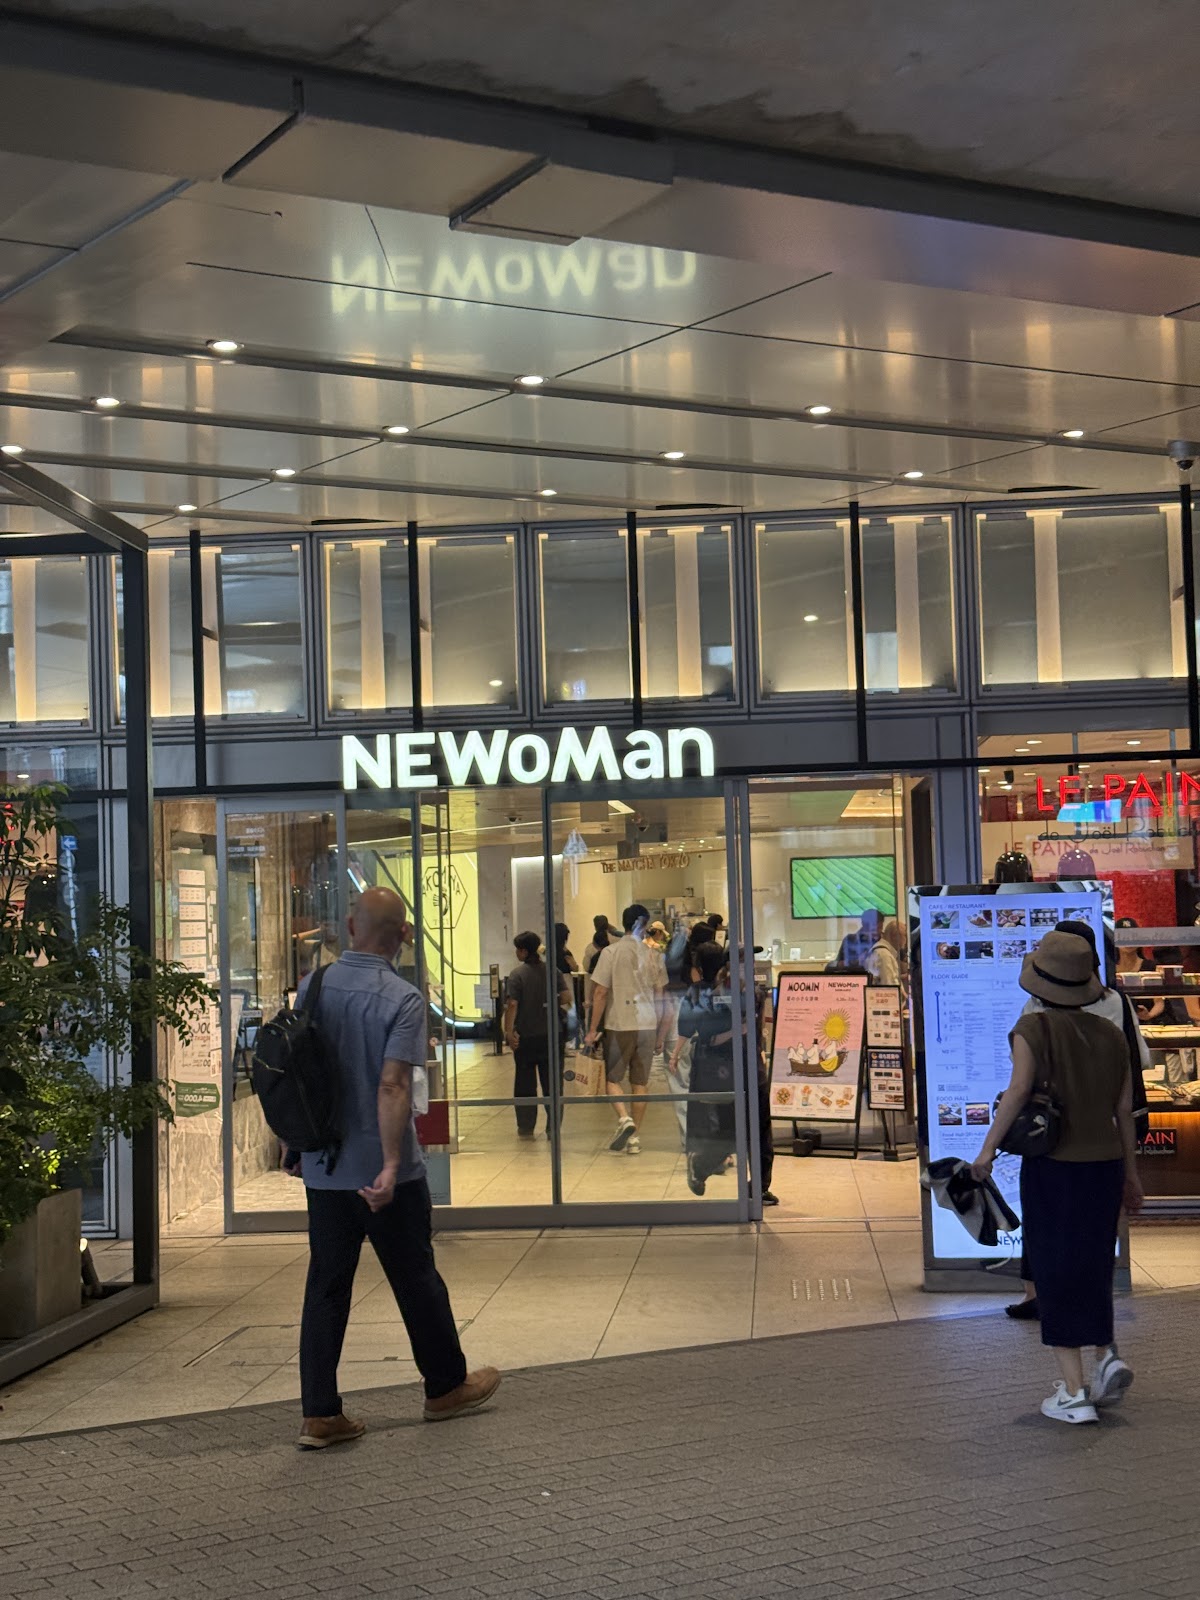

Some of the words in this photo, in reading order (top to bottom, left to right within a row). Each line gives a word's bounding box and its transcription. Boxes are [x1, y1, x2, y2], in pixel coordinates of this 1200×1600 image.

[342, 725, 715, 790] NEWoMan
[1036, 775, 1081, 811] LE
[787, 982, 820, 992] MOOMIN
